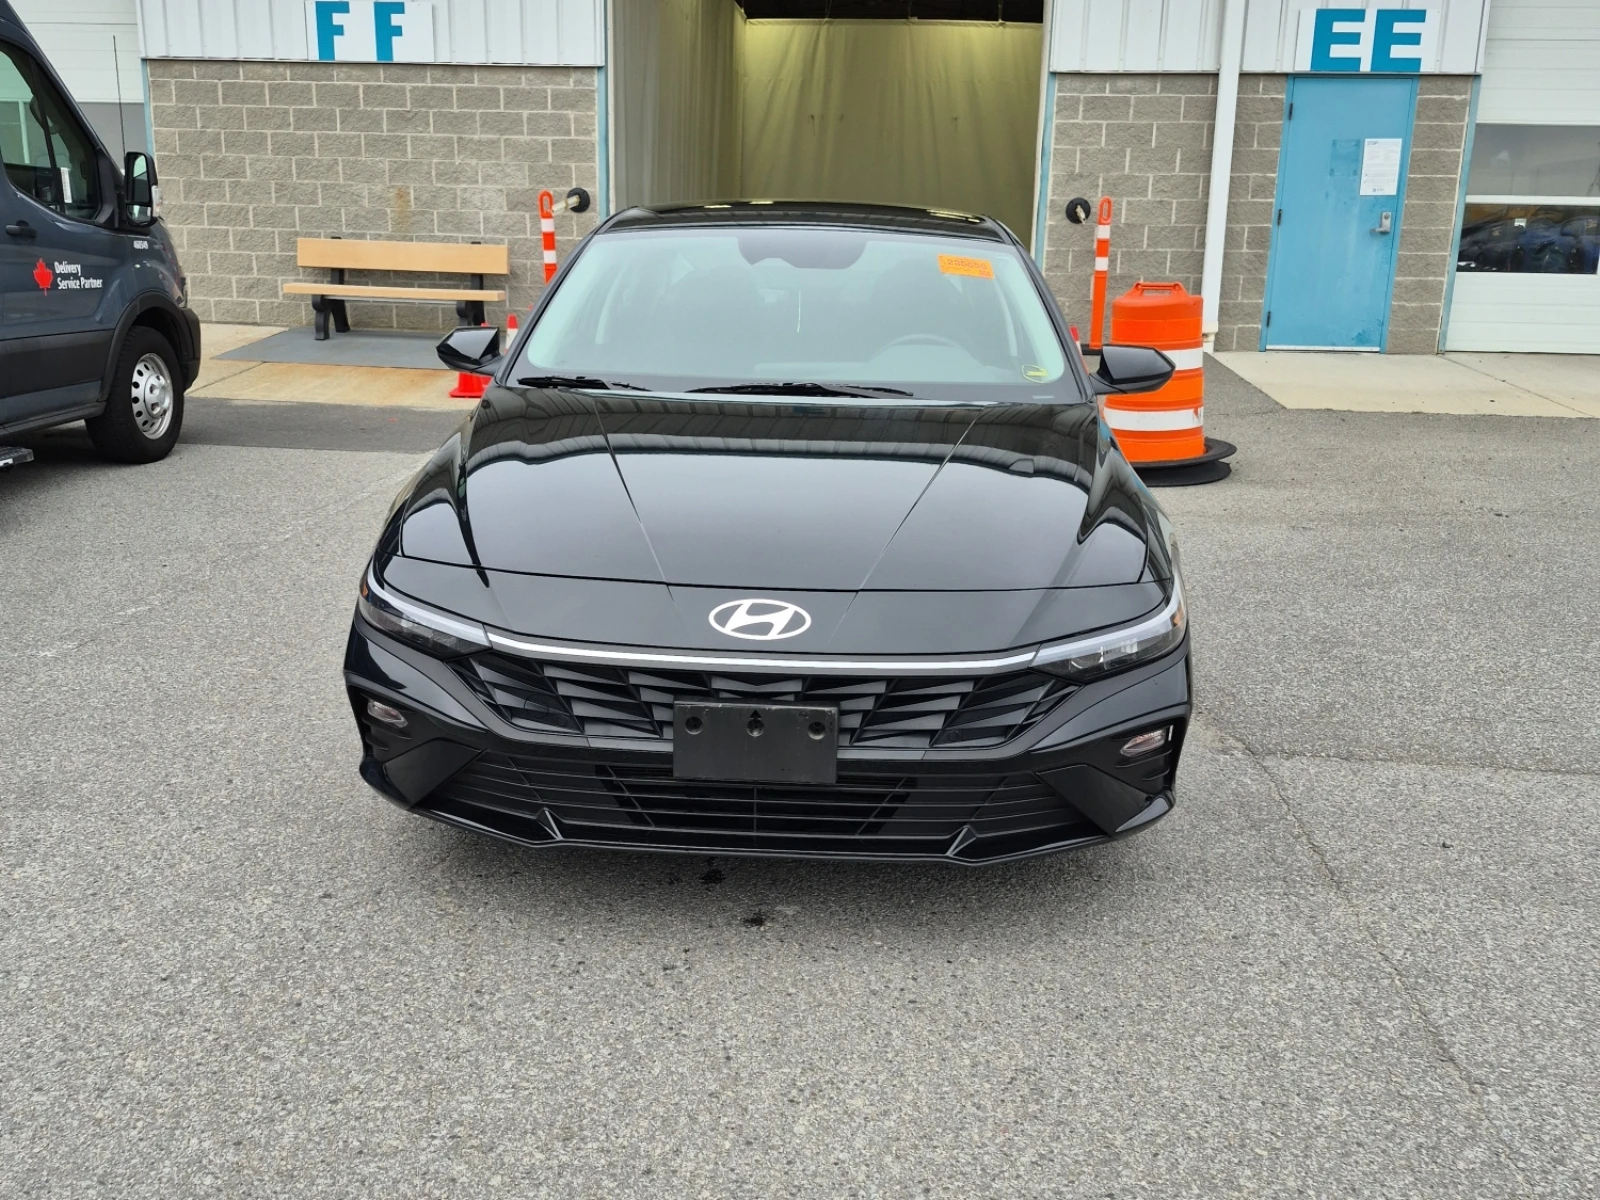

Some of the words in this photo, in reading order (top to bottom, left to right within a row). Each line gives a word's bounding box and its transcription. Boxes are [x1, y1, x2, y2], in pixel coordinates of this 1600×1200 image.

[1310, 8, 1427, 72] EE
[54, 261, 81, 276] Delivery
[57, 276, 80, 290] Service
[80, 276, 103, 289] Partner
